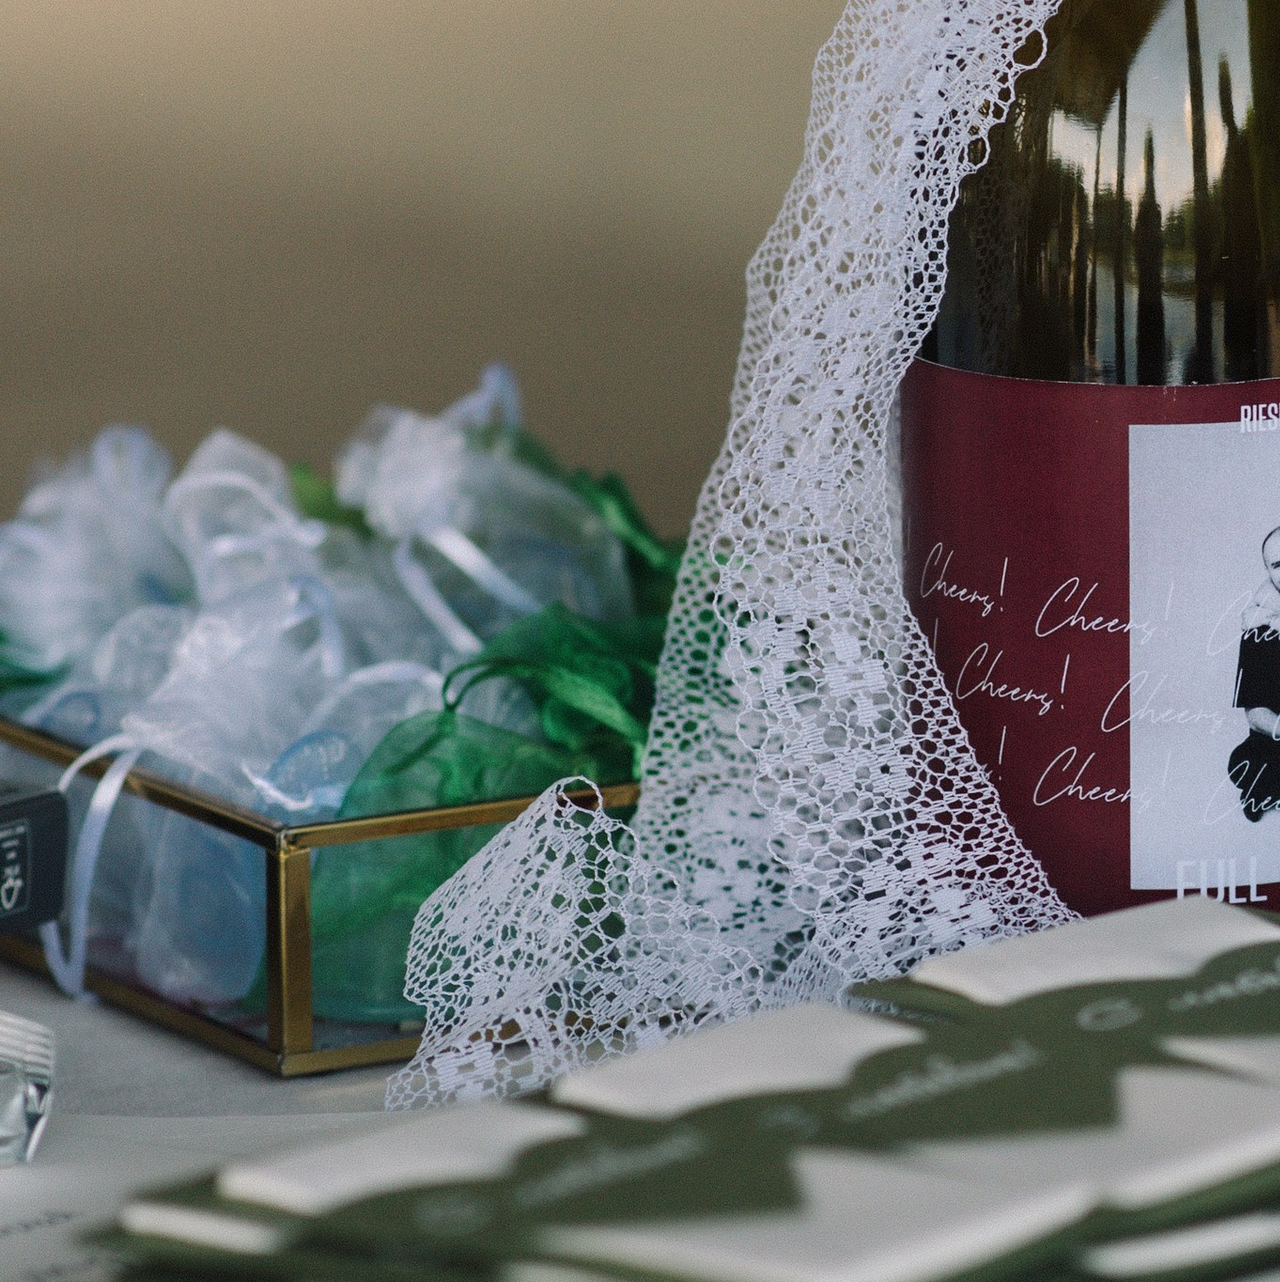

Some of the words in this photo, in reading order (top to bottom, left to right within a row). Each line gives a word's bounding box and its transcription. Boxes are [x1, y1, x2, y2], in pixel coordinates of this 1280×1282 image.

[919, 540, 1008, 618] Cheers!
[955, 641, 1071, 716] Cheers!
[1175, 855, 1268, 905] FULL
